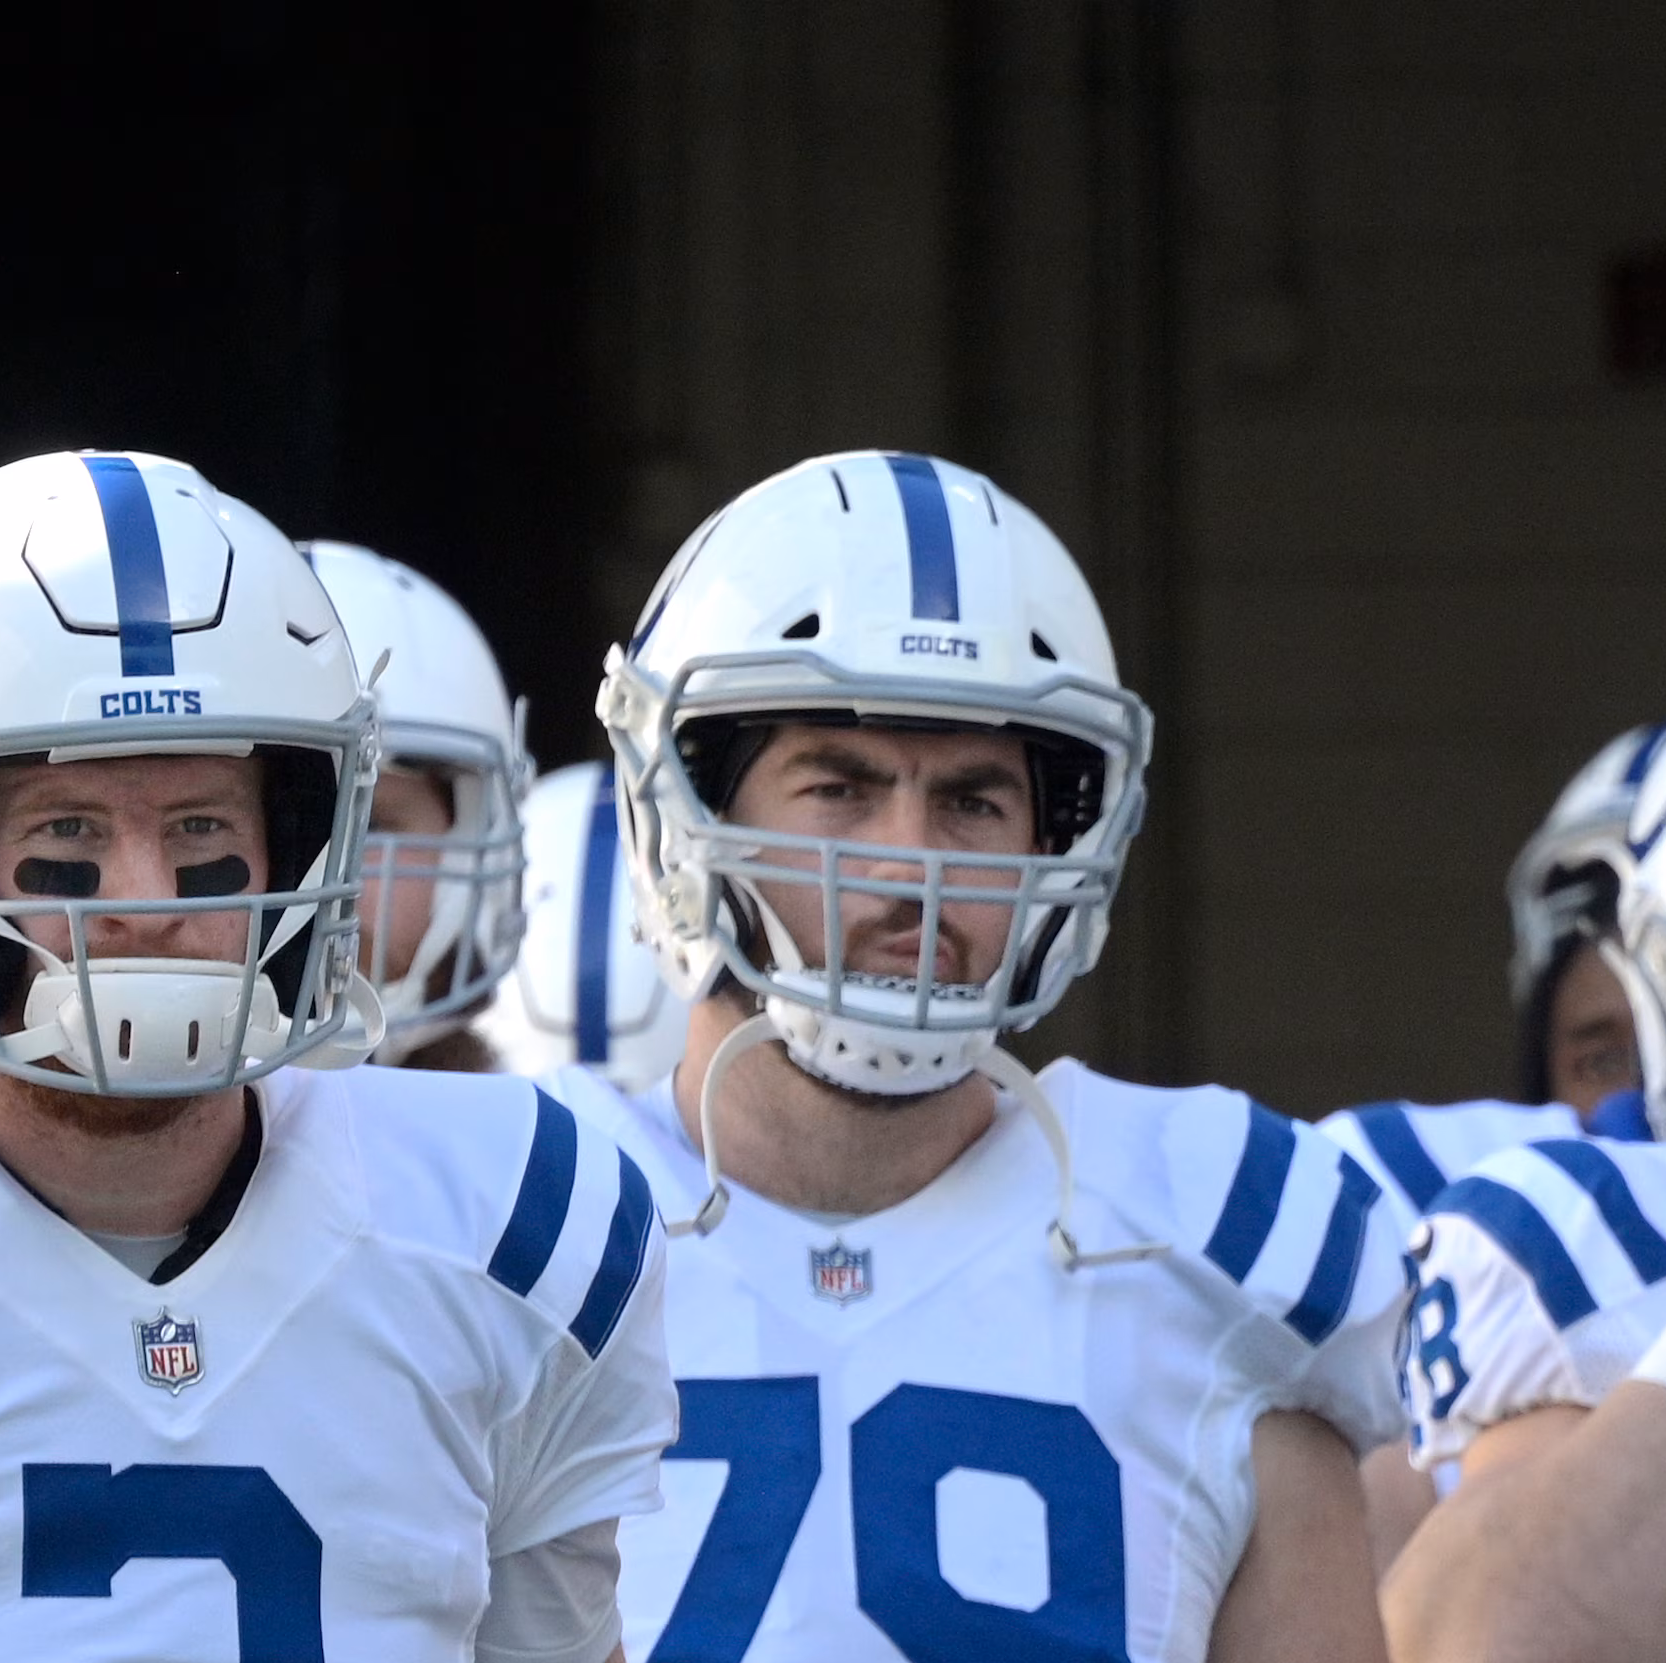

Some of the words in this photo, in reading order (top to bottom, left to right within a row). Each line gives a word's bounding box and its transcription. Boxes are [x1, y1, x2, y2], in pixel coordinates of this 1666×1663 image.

[900, 634, 979, 661] COLTS
[100, 689, 202, 719] COLTS
[148, 1345, 196, 1377] NFL
